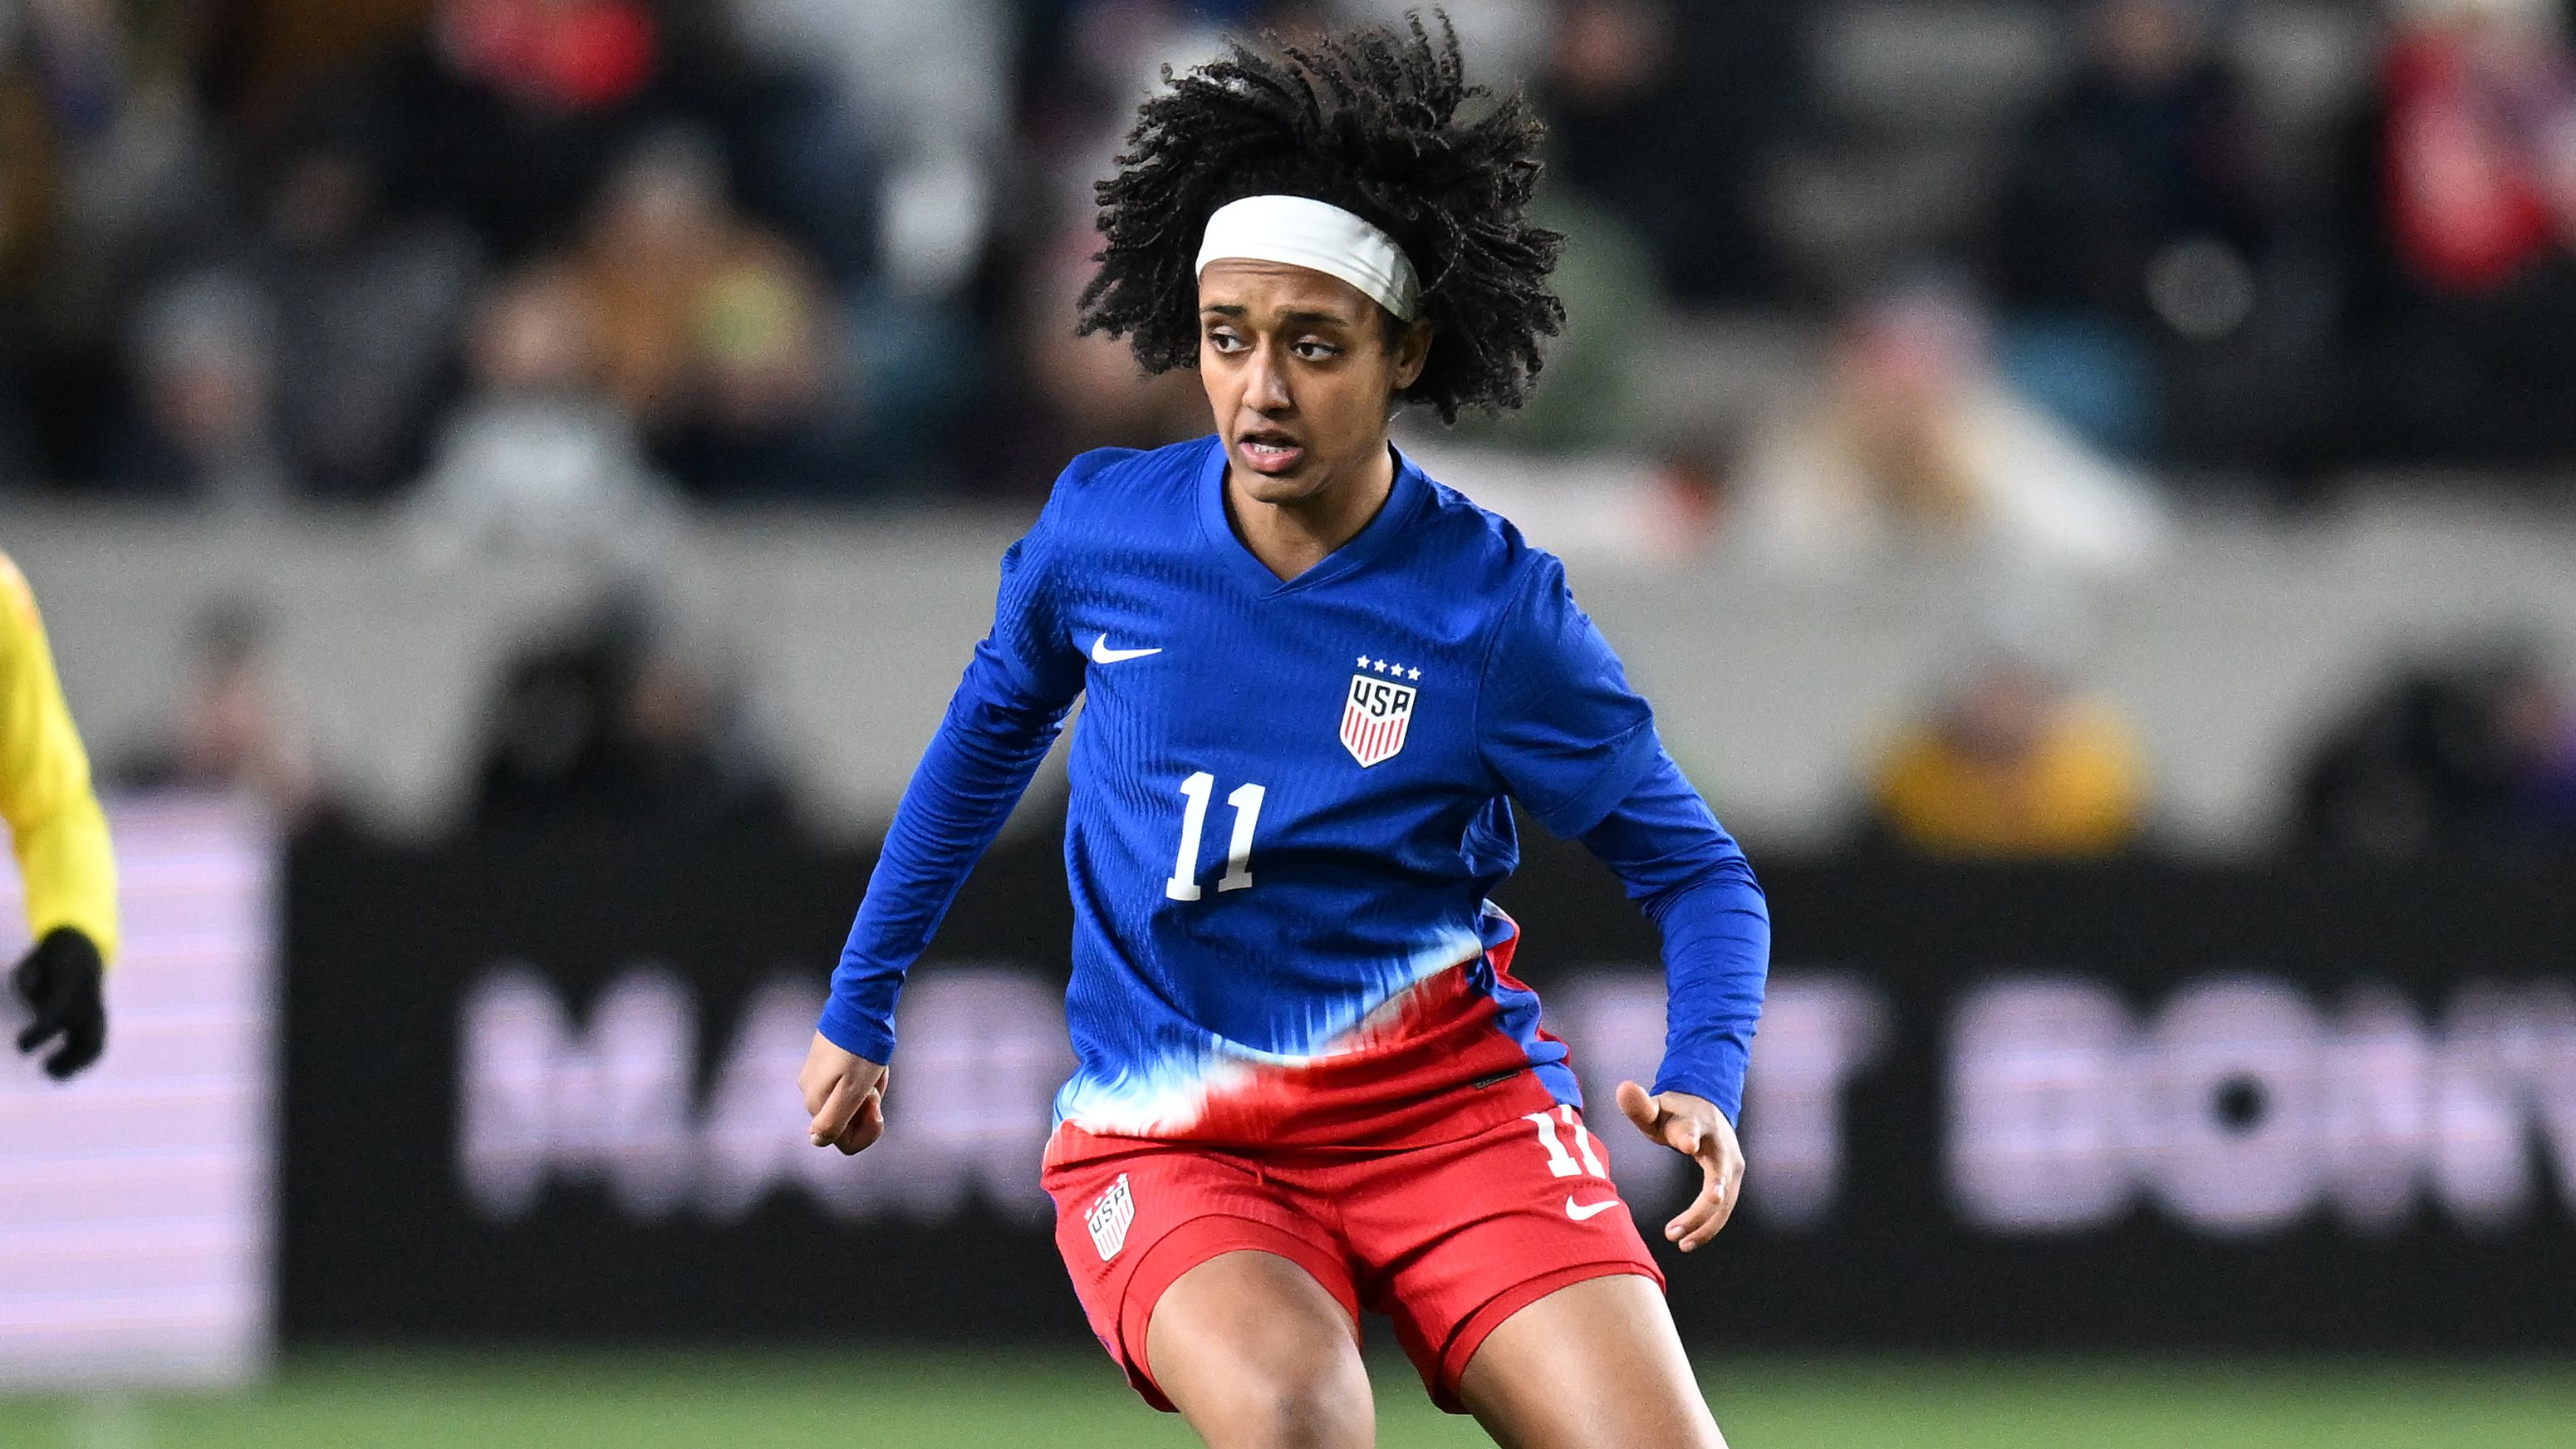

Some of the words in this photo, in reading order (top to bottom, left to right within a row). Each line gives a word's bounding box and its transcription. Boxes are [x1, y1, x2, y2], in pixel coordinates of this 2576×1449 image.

[1353, 680, 1411, 717] USA
[1165, 771, 1266, 901] 11
[1521, 1103, 1607, 1179] 11
[1092, 1186, 1125, 1234] USA
